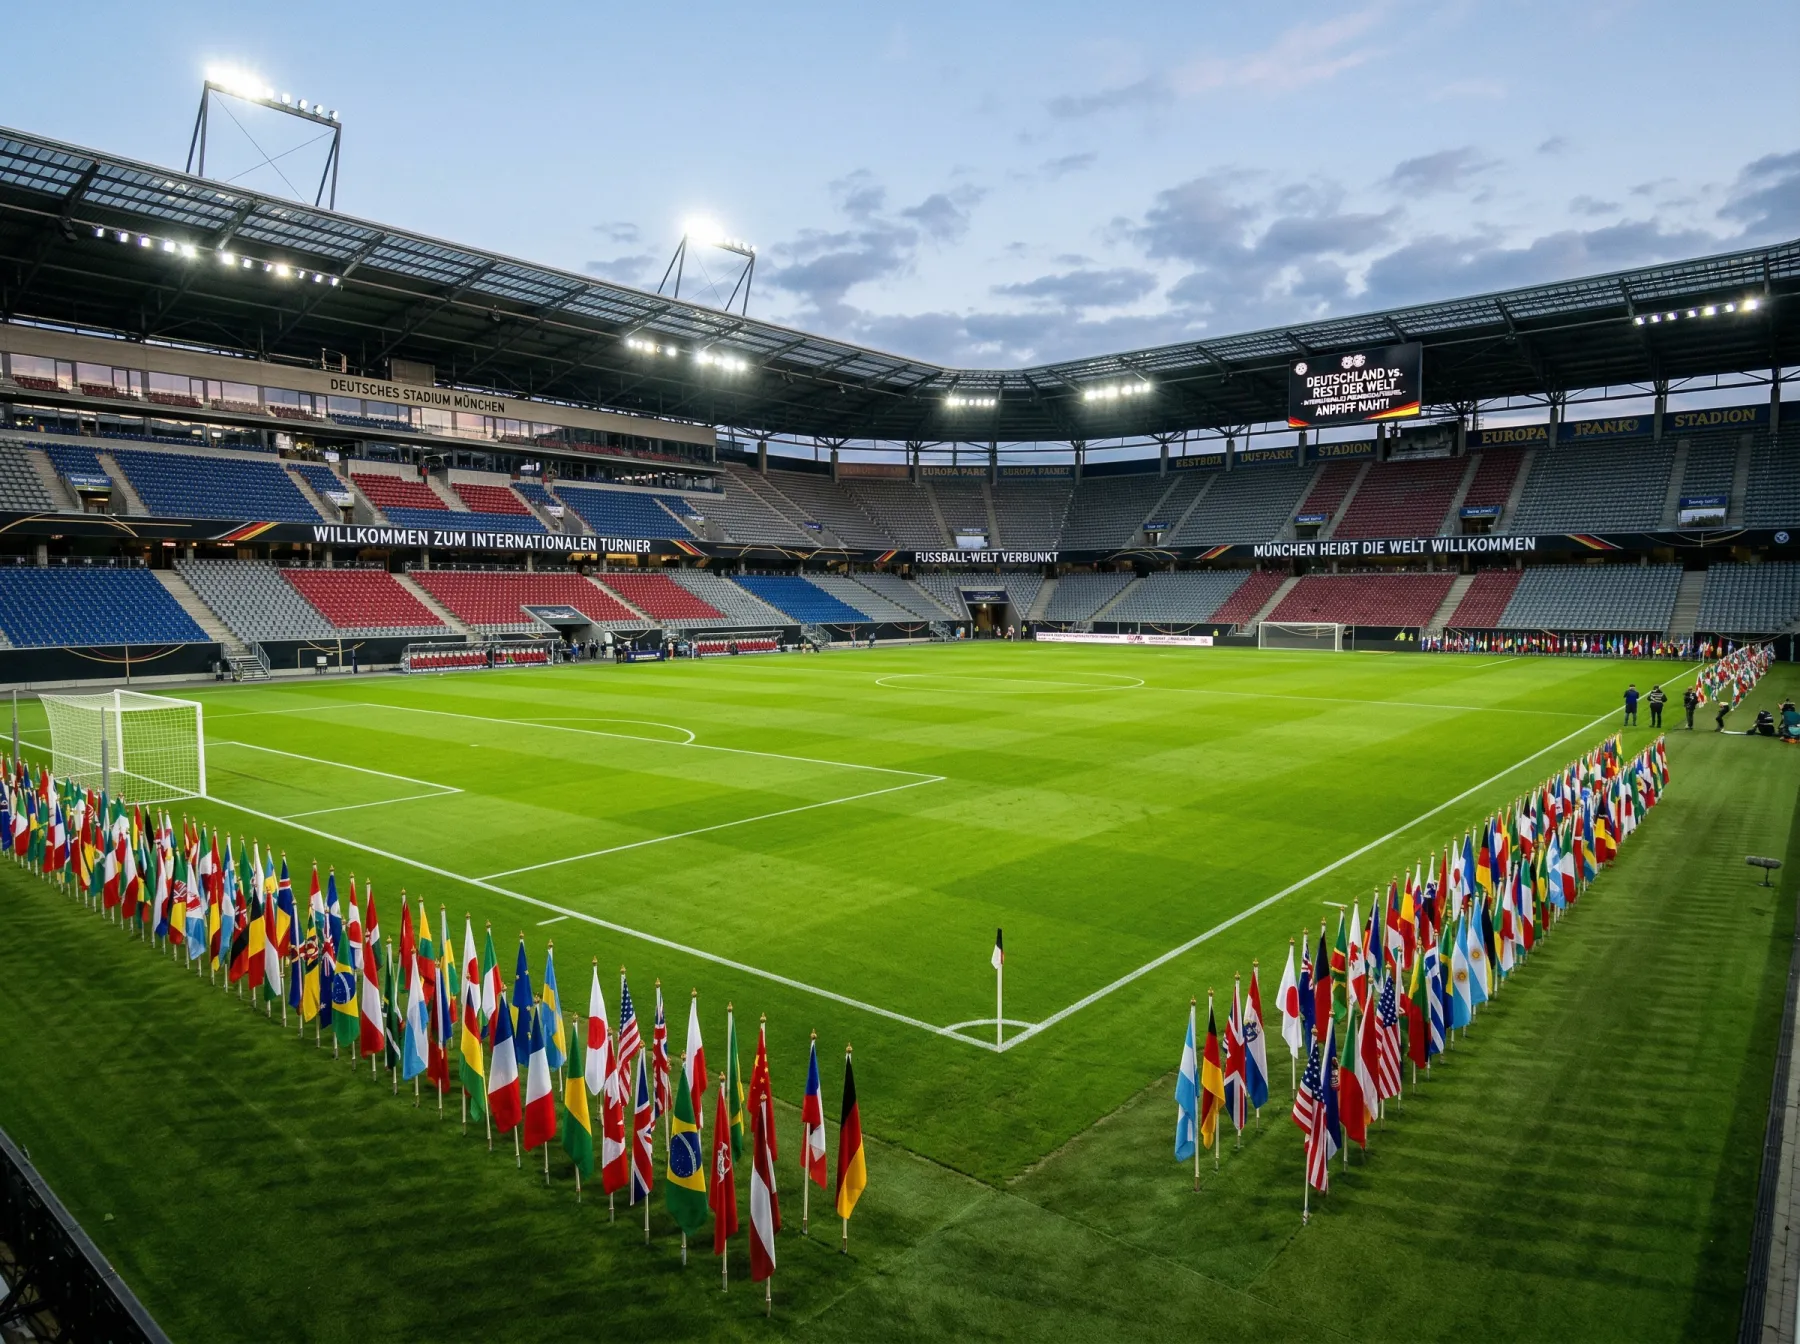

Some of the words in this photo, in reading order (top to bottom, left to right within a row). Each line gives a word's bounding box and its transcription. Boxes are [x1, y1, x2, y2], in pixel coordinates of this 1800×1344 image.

[1306, 368, 1385, 388] DEUTSCHLAND
[330, 378, 400, 399] DEUTSCHES
[403, 389, 450, 406] STADIUM
[454, 394, 505, 413] MÜNCHEN
[1312, 385, 1340, 399] REST
[1342, 382, 1364, 395] DER
[1366, 378, 1397, 392] WELT
[1358, 398, 1389, 412] NAHT!
[1674, 408, 1756, 428] STADION
[1481, 427, 1548, 444] EUROPA
[1318, 443, 1372, 457] STADION
[922, 467, 959, 476] EUROPA
[960, 467, 987, 476] PARK
[313, 526, 429, 546] WILLKOMMEN
[434, 531, 466, 546] ZUM
[472, 532, 596, 551] INTERNATIONALEN
[600, 538, 651, 553] TURNIER
[1254, 542, 1316, 557] MÜNCHEN
[1320, 541, 1359, 556] HEIßT
[1362, 541, 1385, 554] DIE
[1389, 540, 1427, 554] WELT
[1431, 537, 1536, 552] WILLKOMMEN
[915, 552, 999, 563] FUSSBALL-WELT
[1002, 551, 1059, 563] VERBUNKT
